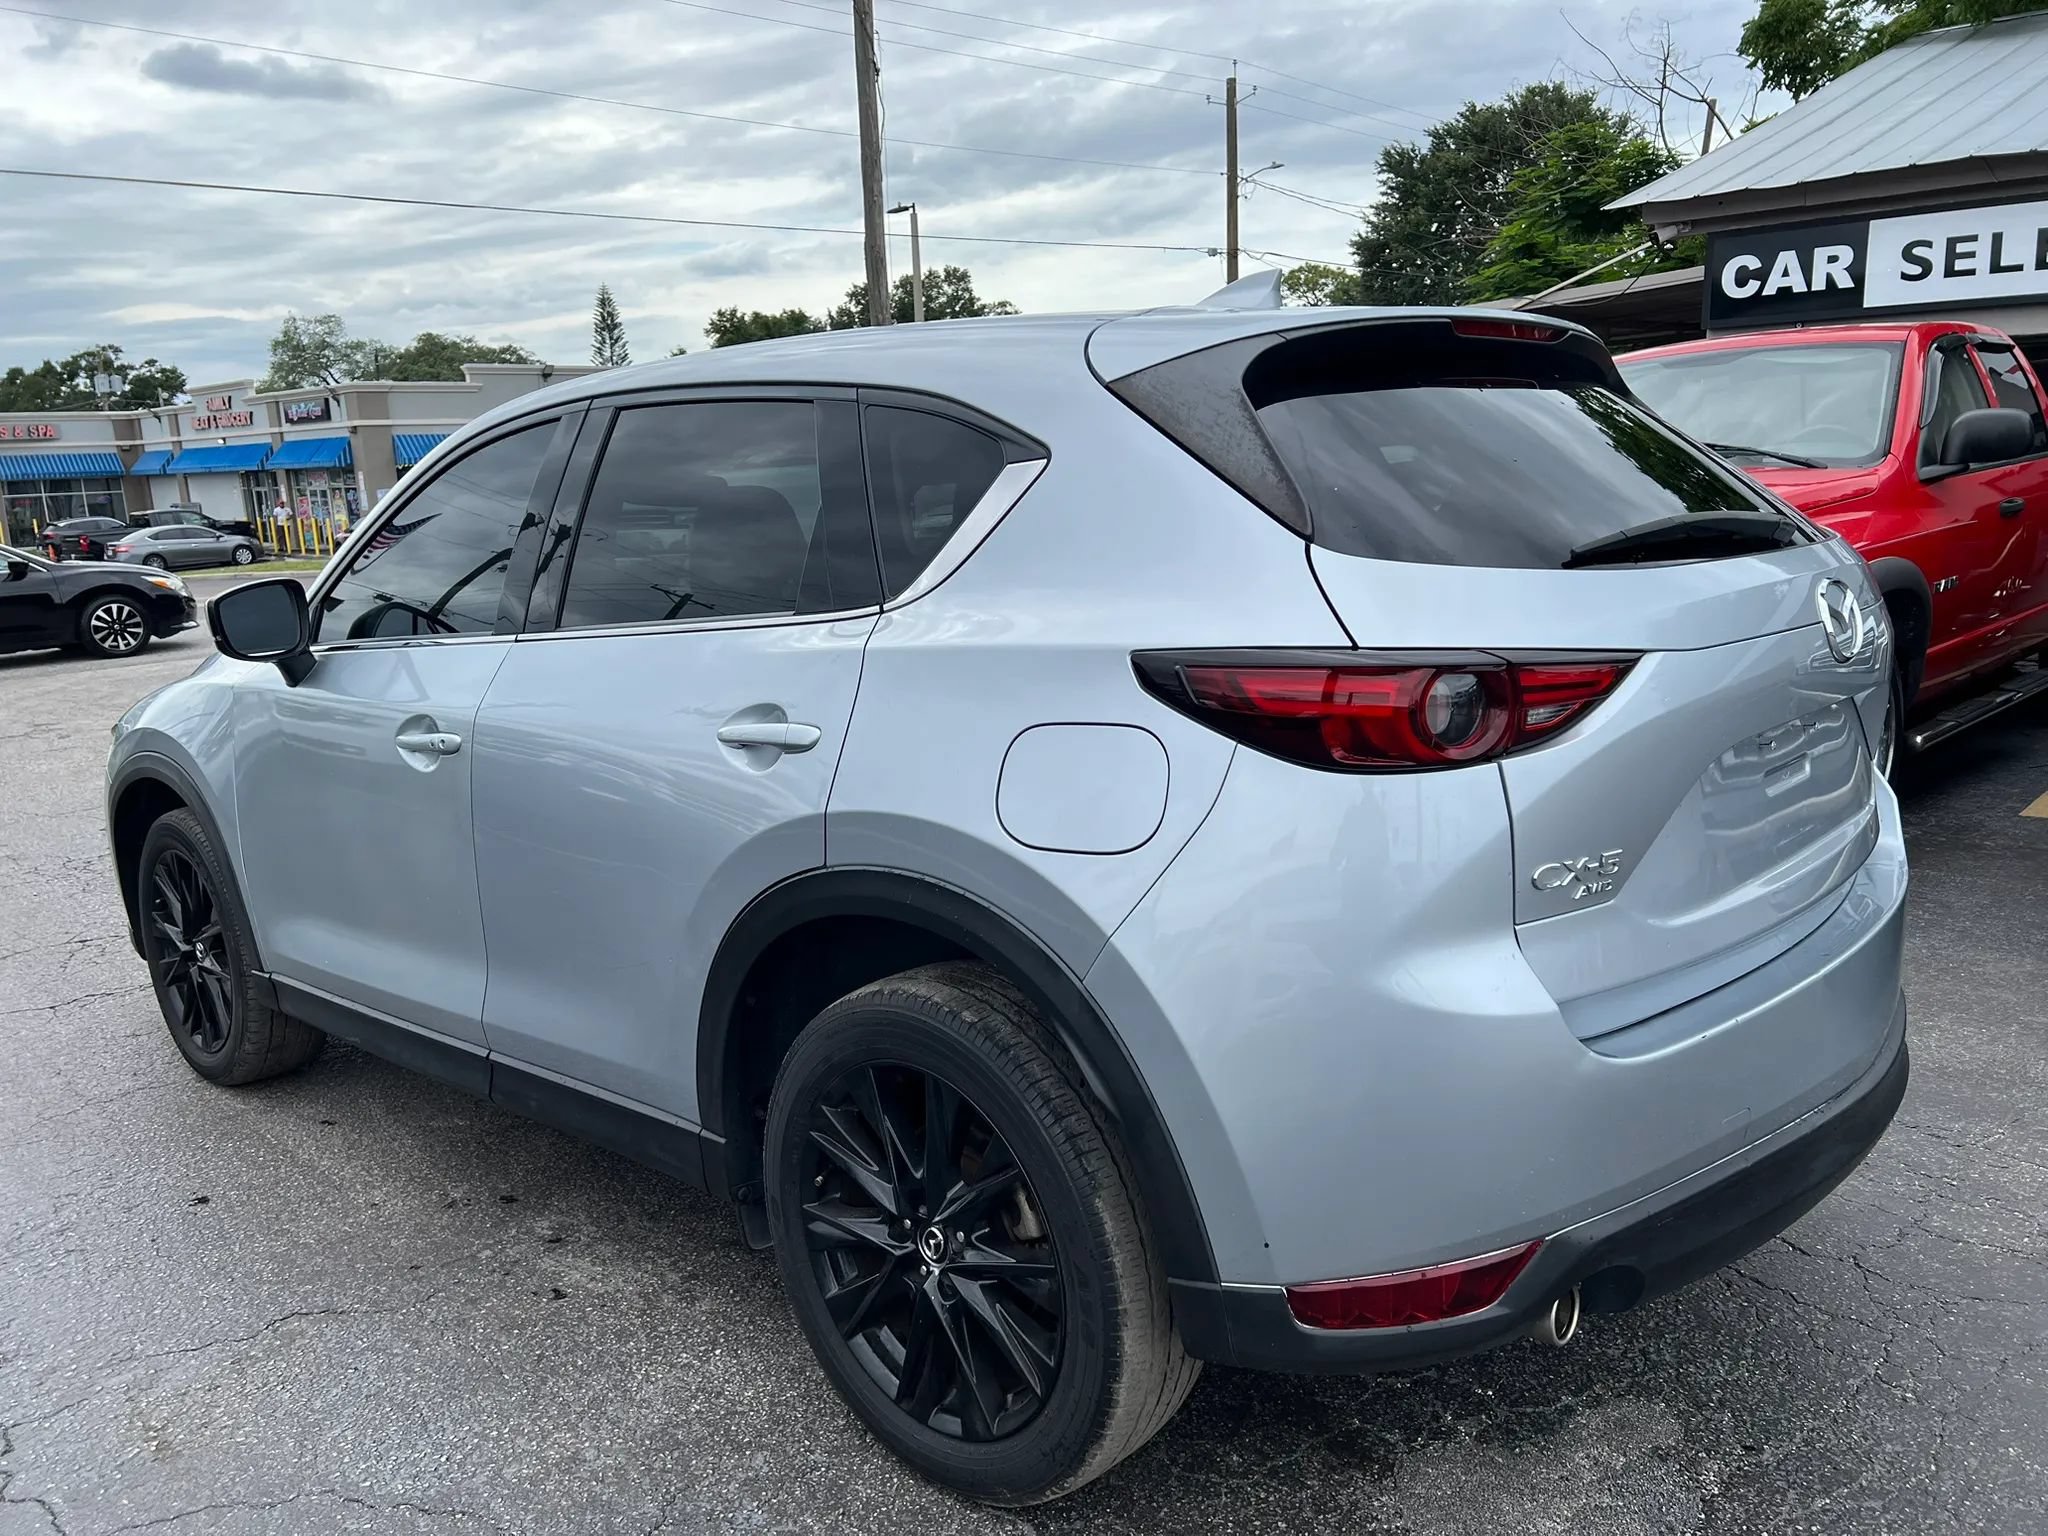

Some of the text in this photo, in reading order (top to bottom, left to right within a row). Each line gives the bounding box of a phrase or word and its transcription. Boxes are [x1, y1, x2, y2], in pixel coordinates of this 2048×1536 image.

[1720, 244, 1855, 299] CAR
[219, 411, 253, 428] GROCERY
[13, 425, 24, 438] &
[28, 425, 56, 438] SPA
[1531, 848, 1623, 891] CX-5
[1571, 879, 1613, 900] AWD
